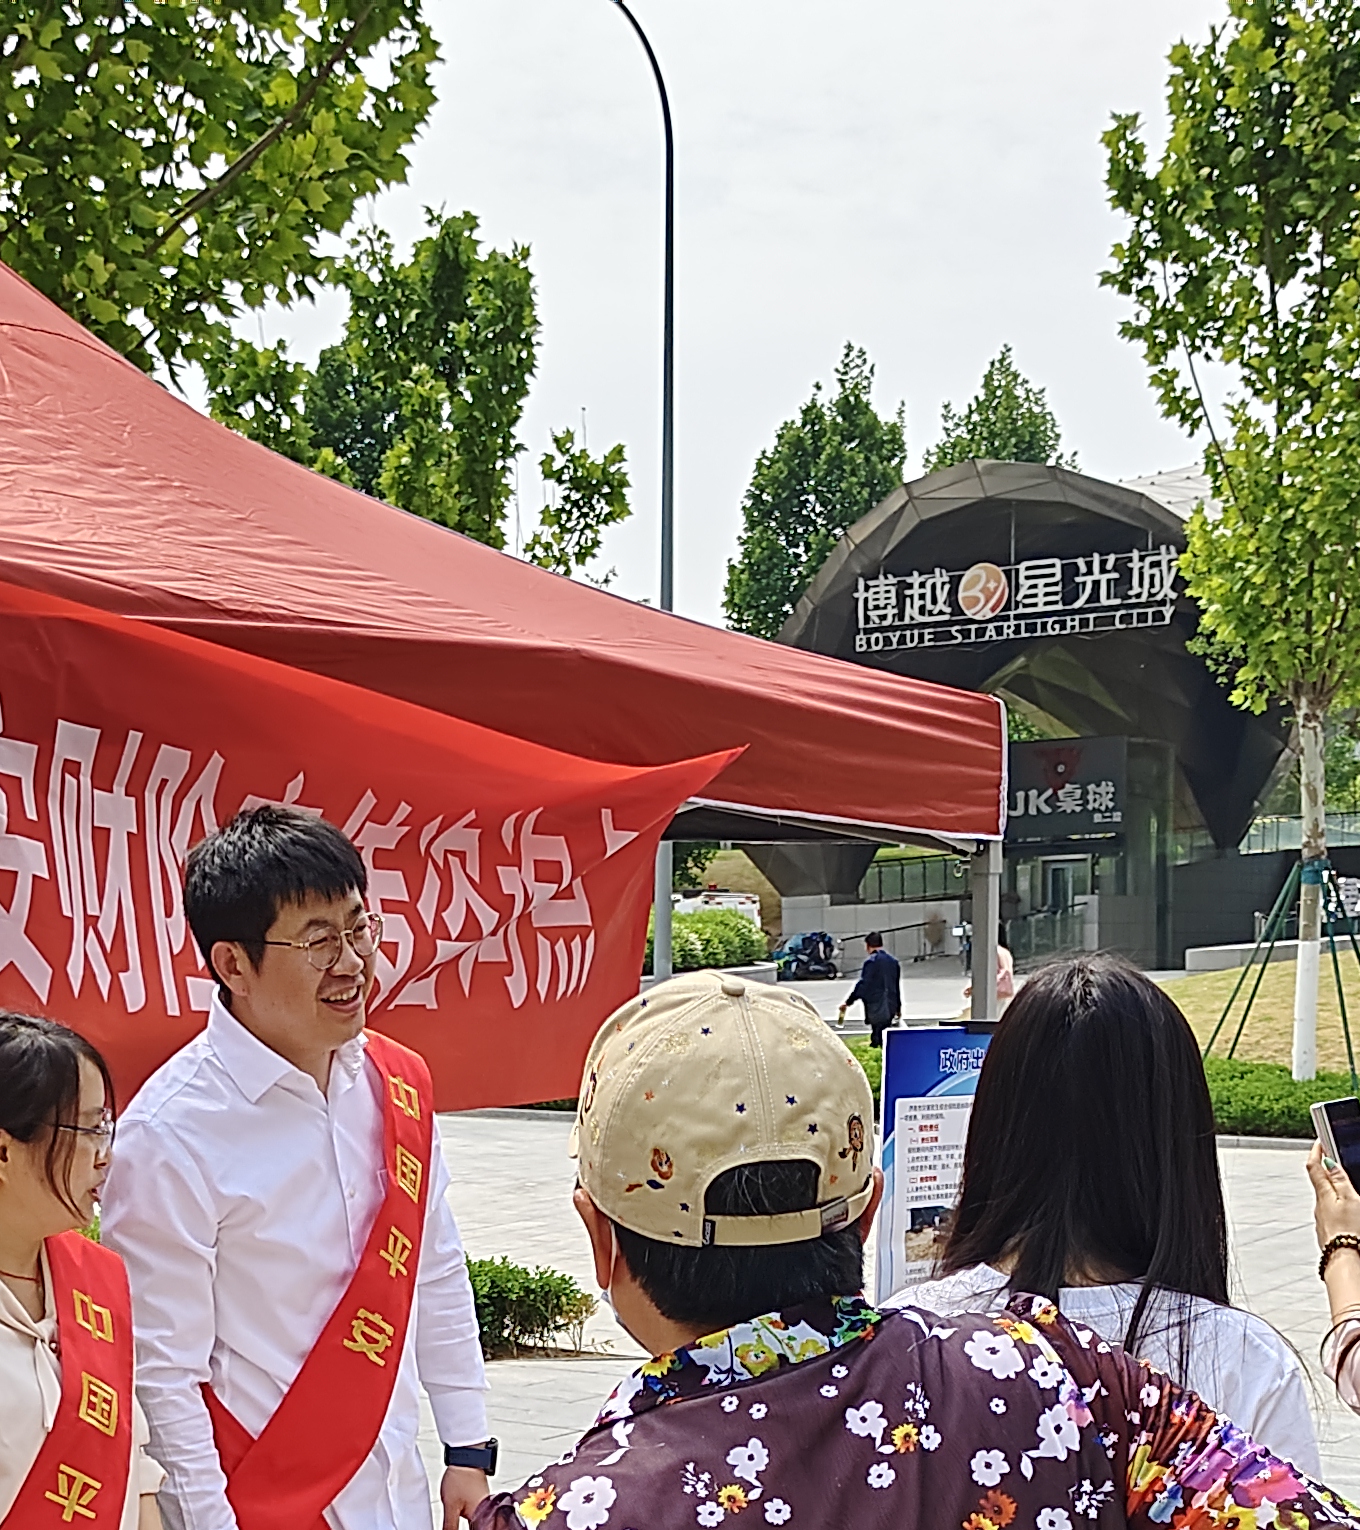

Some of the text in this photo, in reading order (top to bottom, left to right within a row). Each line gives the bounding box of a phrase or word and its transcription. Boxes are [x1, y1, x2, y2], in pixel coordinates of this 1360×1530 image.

[853, 545, 1180, 629] 博越 星光城
[855, 605, 1175, 652] BOYUE STARLIGHT CITY
[1008, 781, 1115, 817] JK桌球
[342, 1075, 422, 1367] 中国平安
